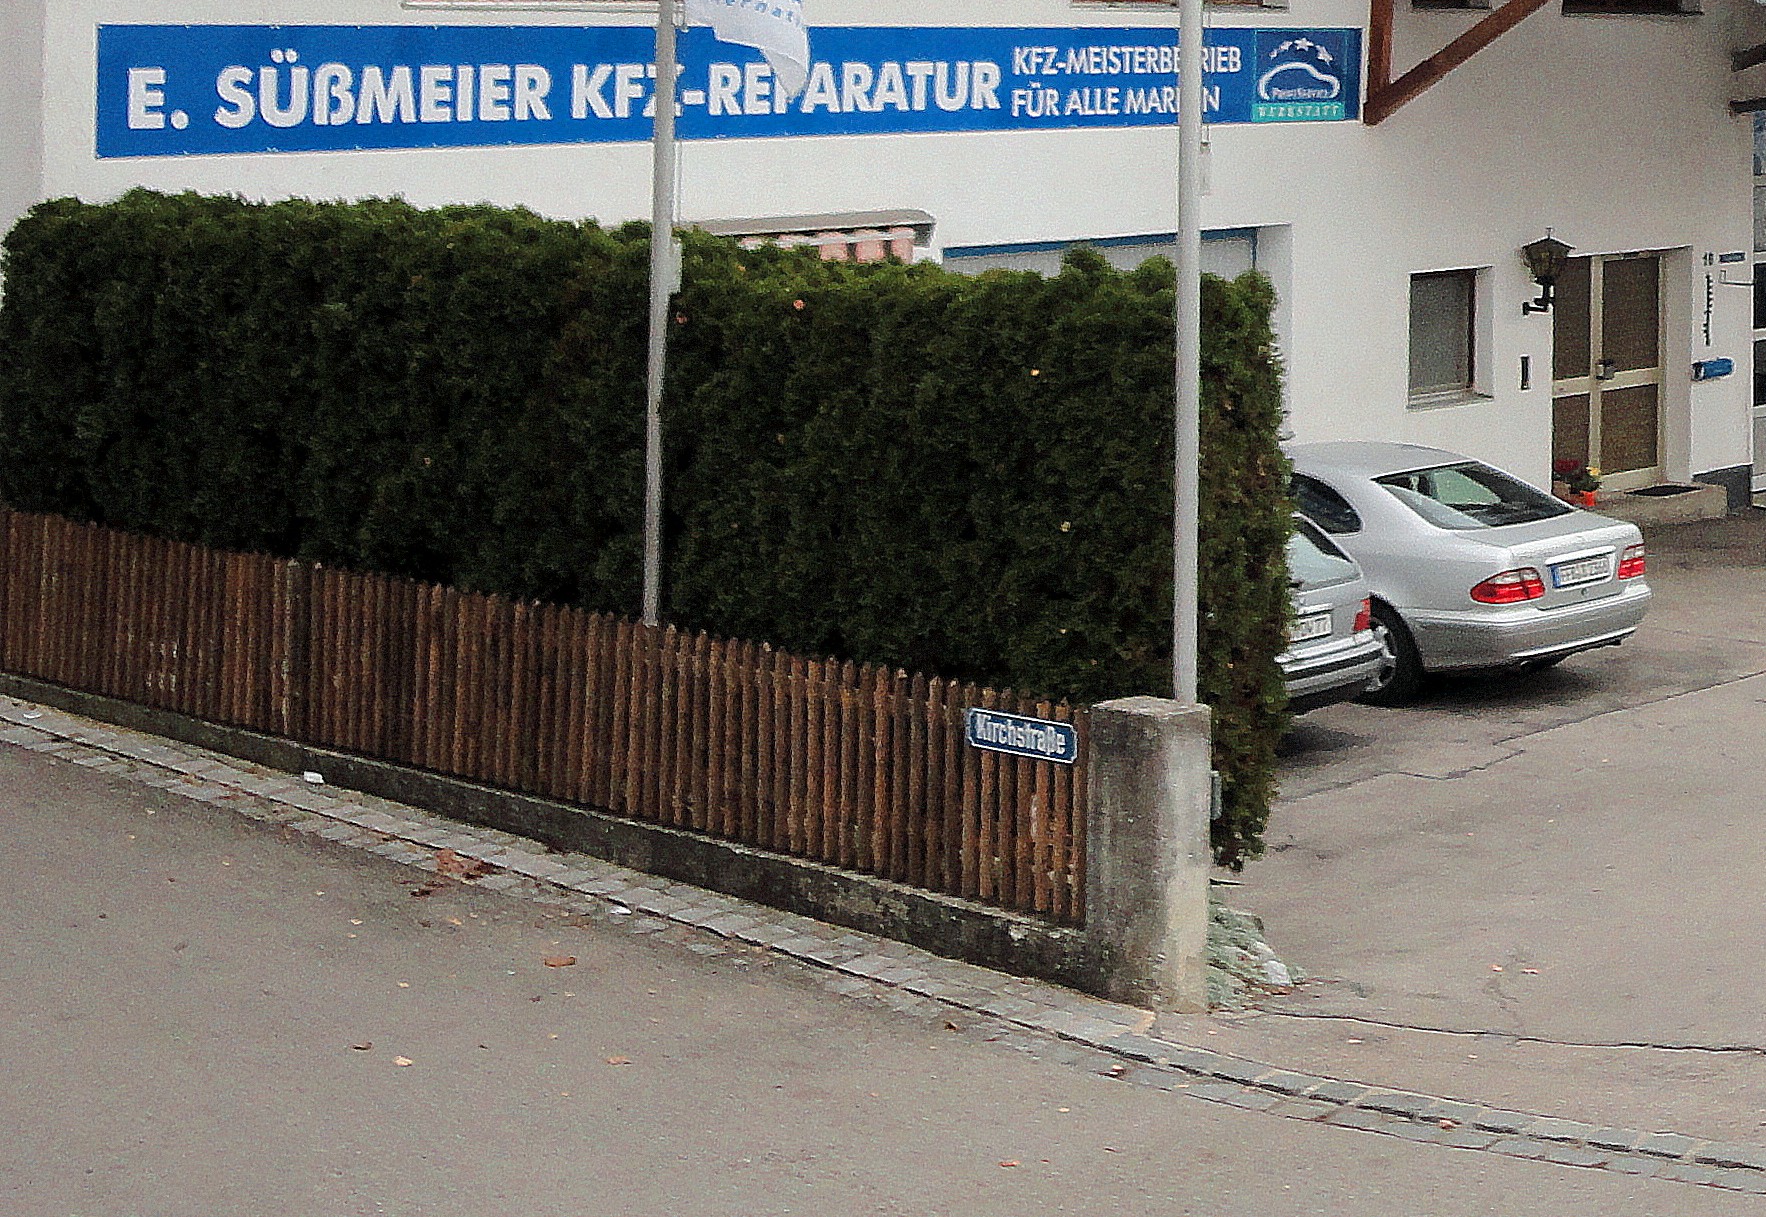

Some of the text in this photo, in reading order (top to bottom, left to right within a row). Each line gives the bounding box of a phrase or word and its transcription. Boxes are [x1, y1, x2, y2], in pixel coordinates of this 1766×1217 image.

[1012, 46, 1242, 76] KFZ-MEISTERBERIEB
[127, 66, 190, 130] E.
[1011, 80, 1221, 117] FÜR ALLE MARN
